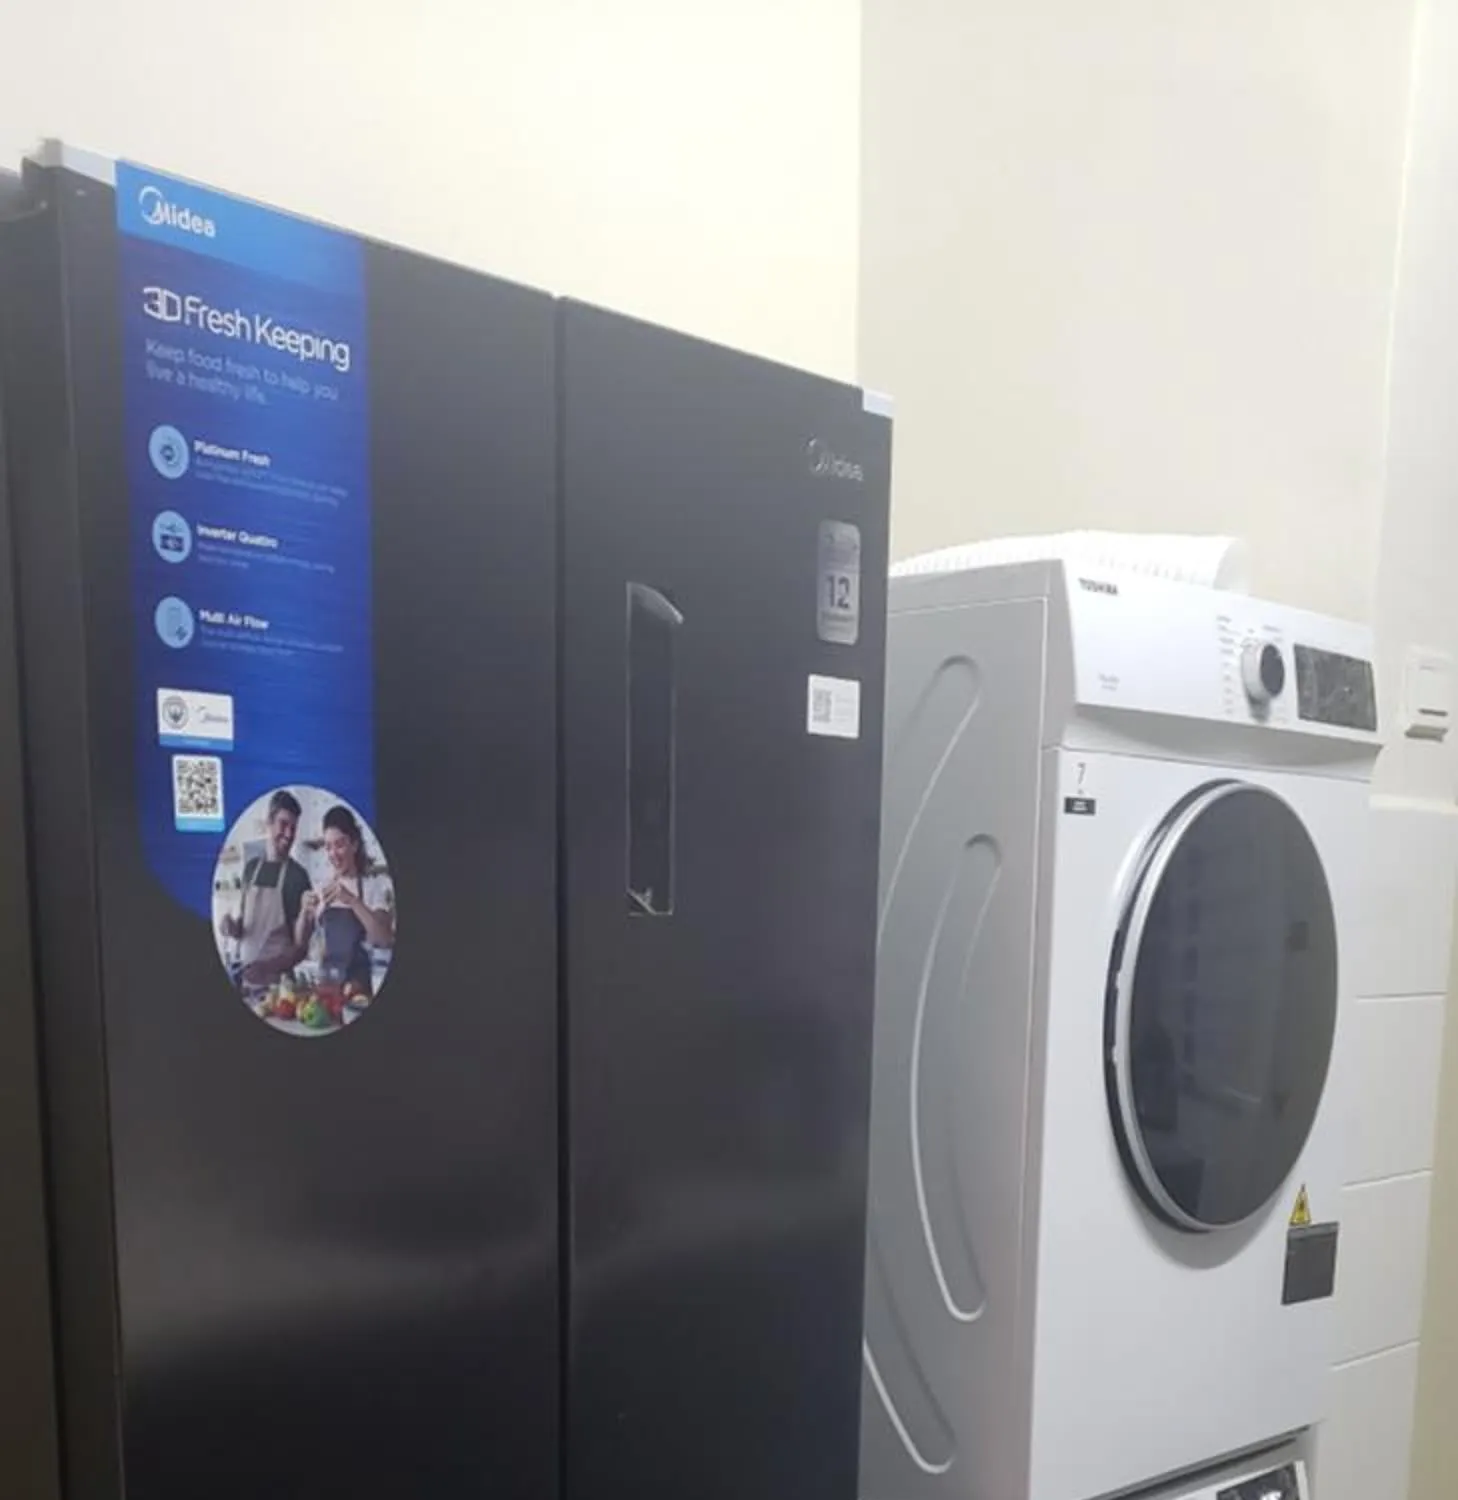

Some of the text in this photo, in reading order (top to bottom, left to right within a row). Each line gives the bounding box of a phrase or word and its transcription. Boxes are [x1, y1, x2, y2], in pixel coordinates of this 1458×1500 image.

[138, 185, 216, 238] Midea
[143, 285, 351, 373] 3D Fresh Keeping
[145, 338, 186, 365] Keep
[188, 349, 223, 372] food
[263, 368, 279, 386] to
[313, 383, 339, 401] you
[826, 574, 851, 609] 12
